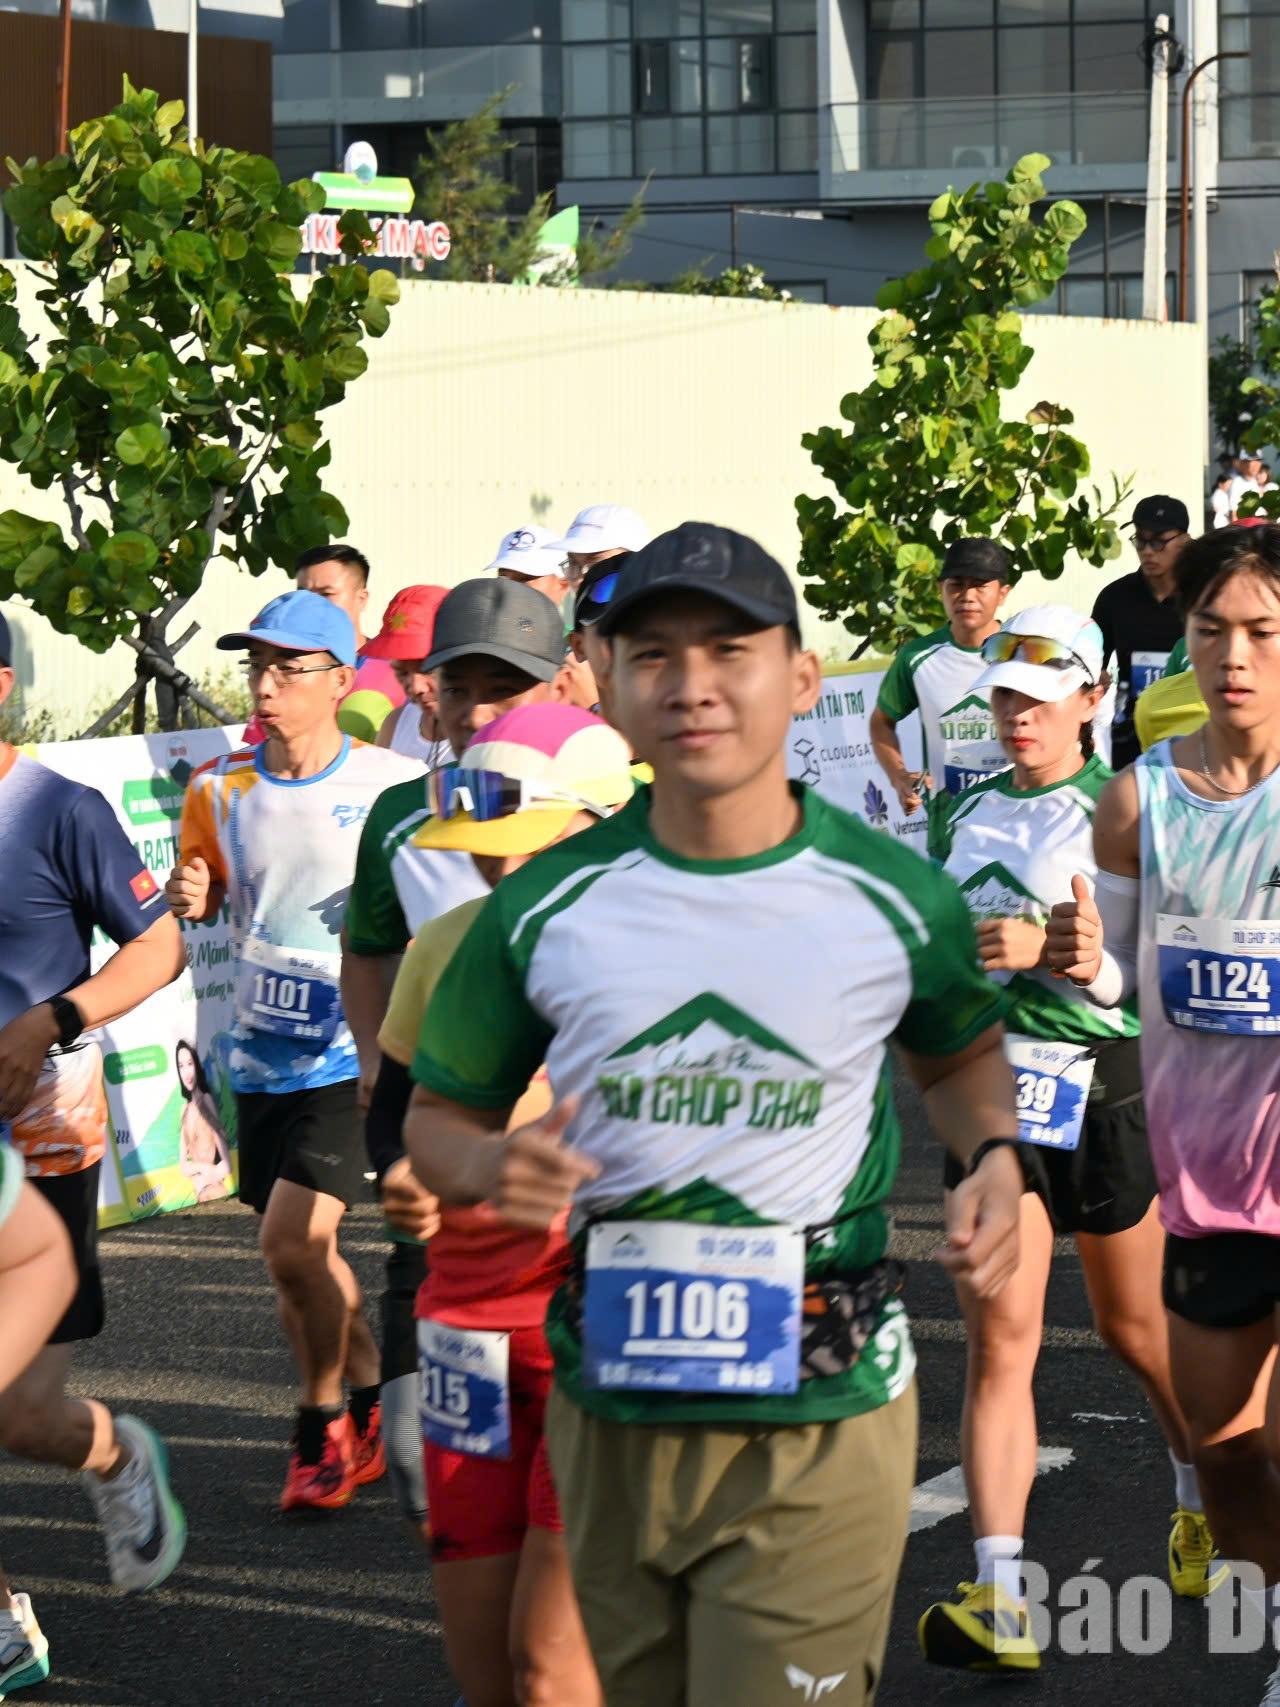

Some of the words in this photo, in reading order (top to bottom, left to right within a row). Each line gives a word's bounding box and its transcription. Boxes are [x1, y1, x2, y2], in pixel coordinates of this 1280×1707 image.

[826, 690, 844, 720] TÀI
[845, 688, 866, 719] TRỢ
[820, 743, 873, 762] CLOUDGA
[254, 973, 312, 1012] 1101
[1187, 959, 1271, 1000] 1124
[624, 1279, 749, 1341] 1106
